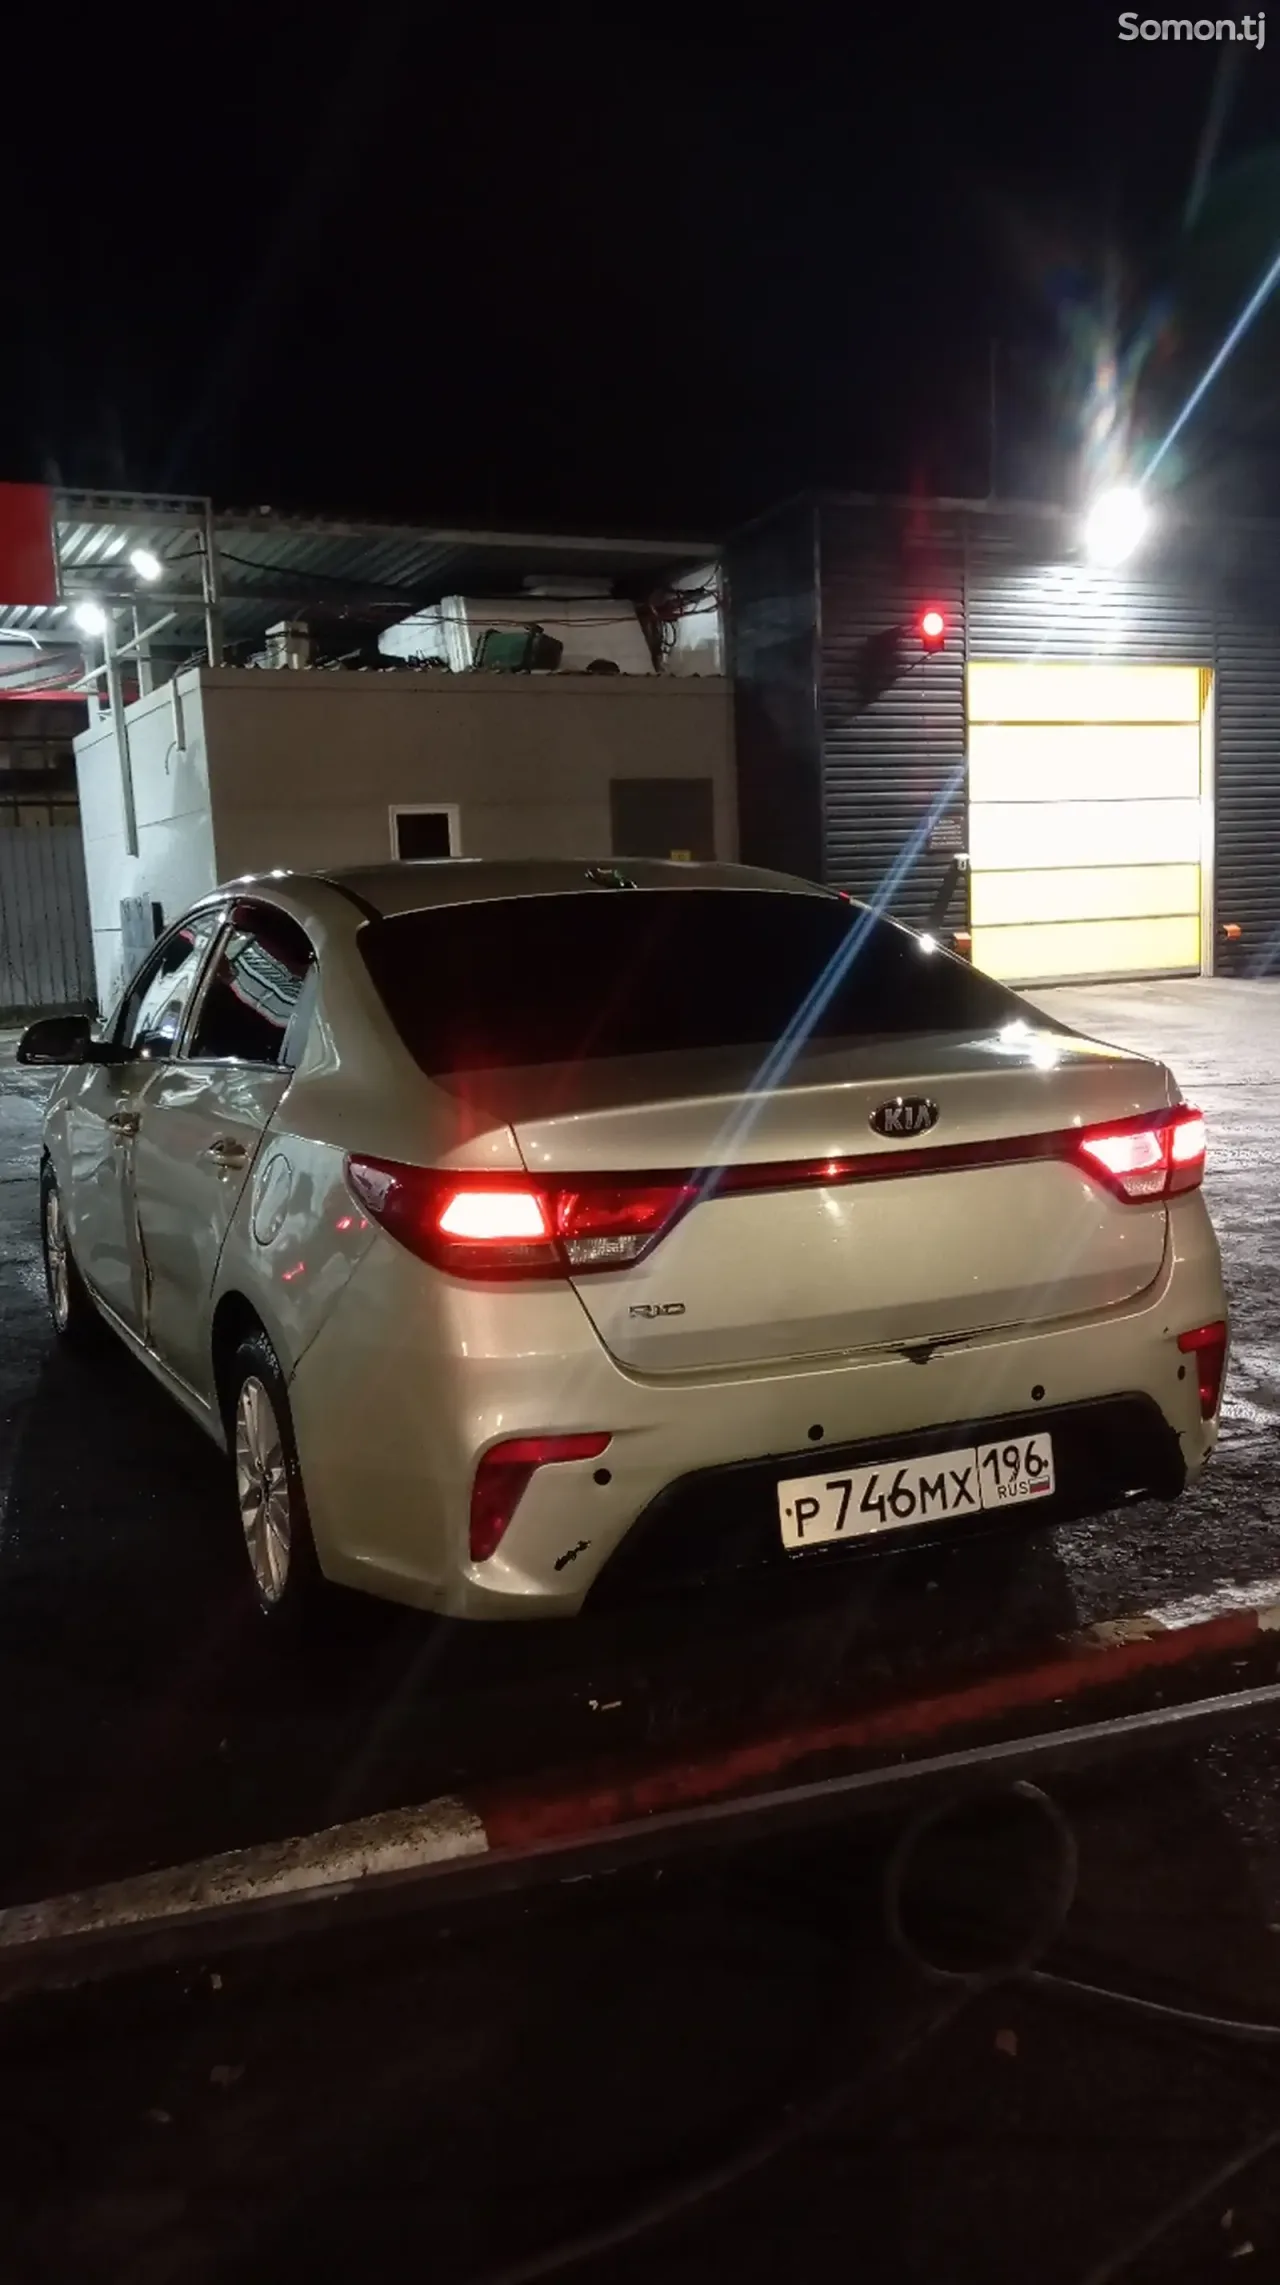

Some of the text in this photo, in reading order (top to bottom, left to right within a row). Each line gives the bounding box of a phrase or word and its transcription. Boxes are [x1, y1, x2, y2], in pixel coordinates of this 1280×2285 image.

[884, 1105, 931, 1131] KIA
[983, 1441, 1043, 1485] 196
[997, 1481, 1028, 1499] RUS
